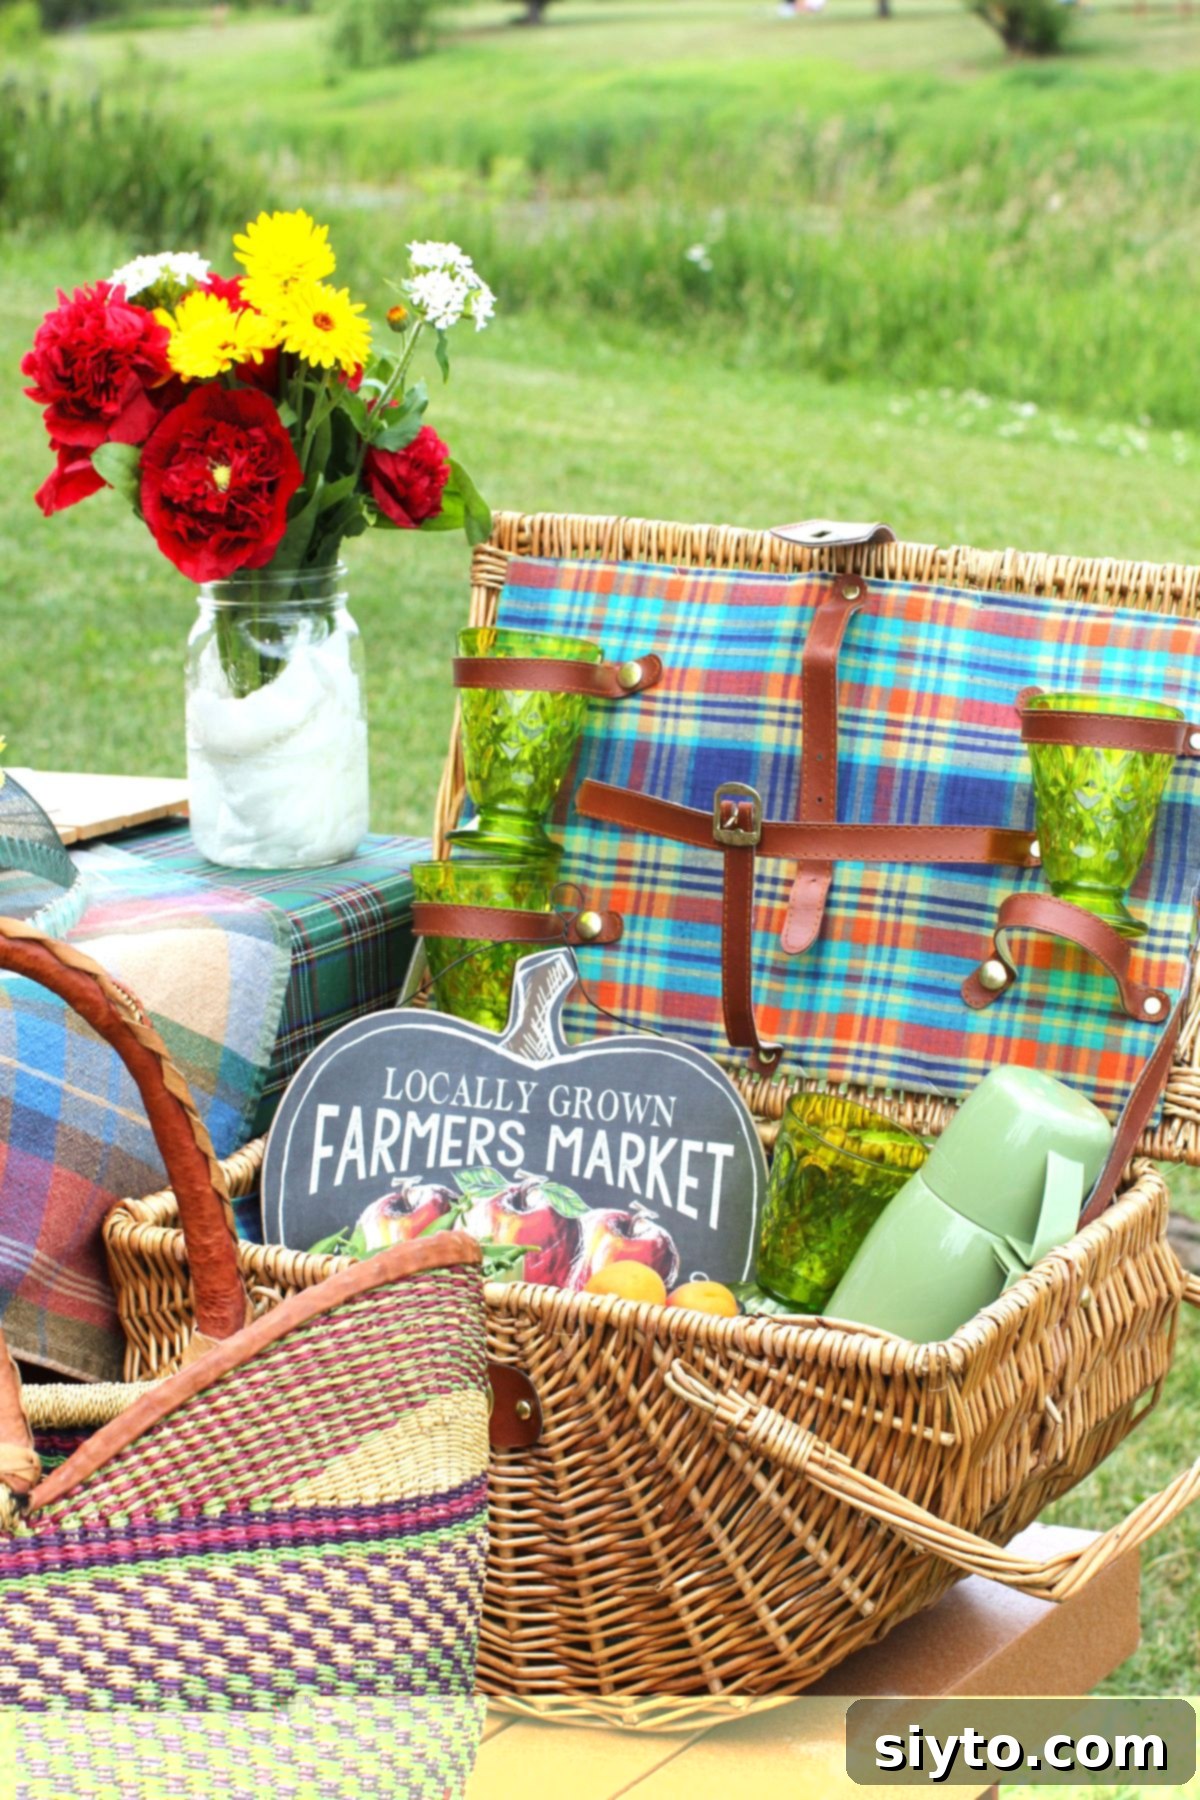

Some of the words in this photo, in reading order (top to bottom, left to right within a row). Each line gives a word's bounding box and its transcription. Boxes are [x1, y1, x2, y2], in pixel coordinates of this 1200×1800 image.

[383, 1066, 538, 1114] LOCALLY
[547, 1084, 676, 1128] GROWN
[309, 1103, 526, 1195] FARMERS
[546, 1125, 734, 1230] MARKET
